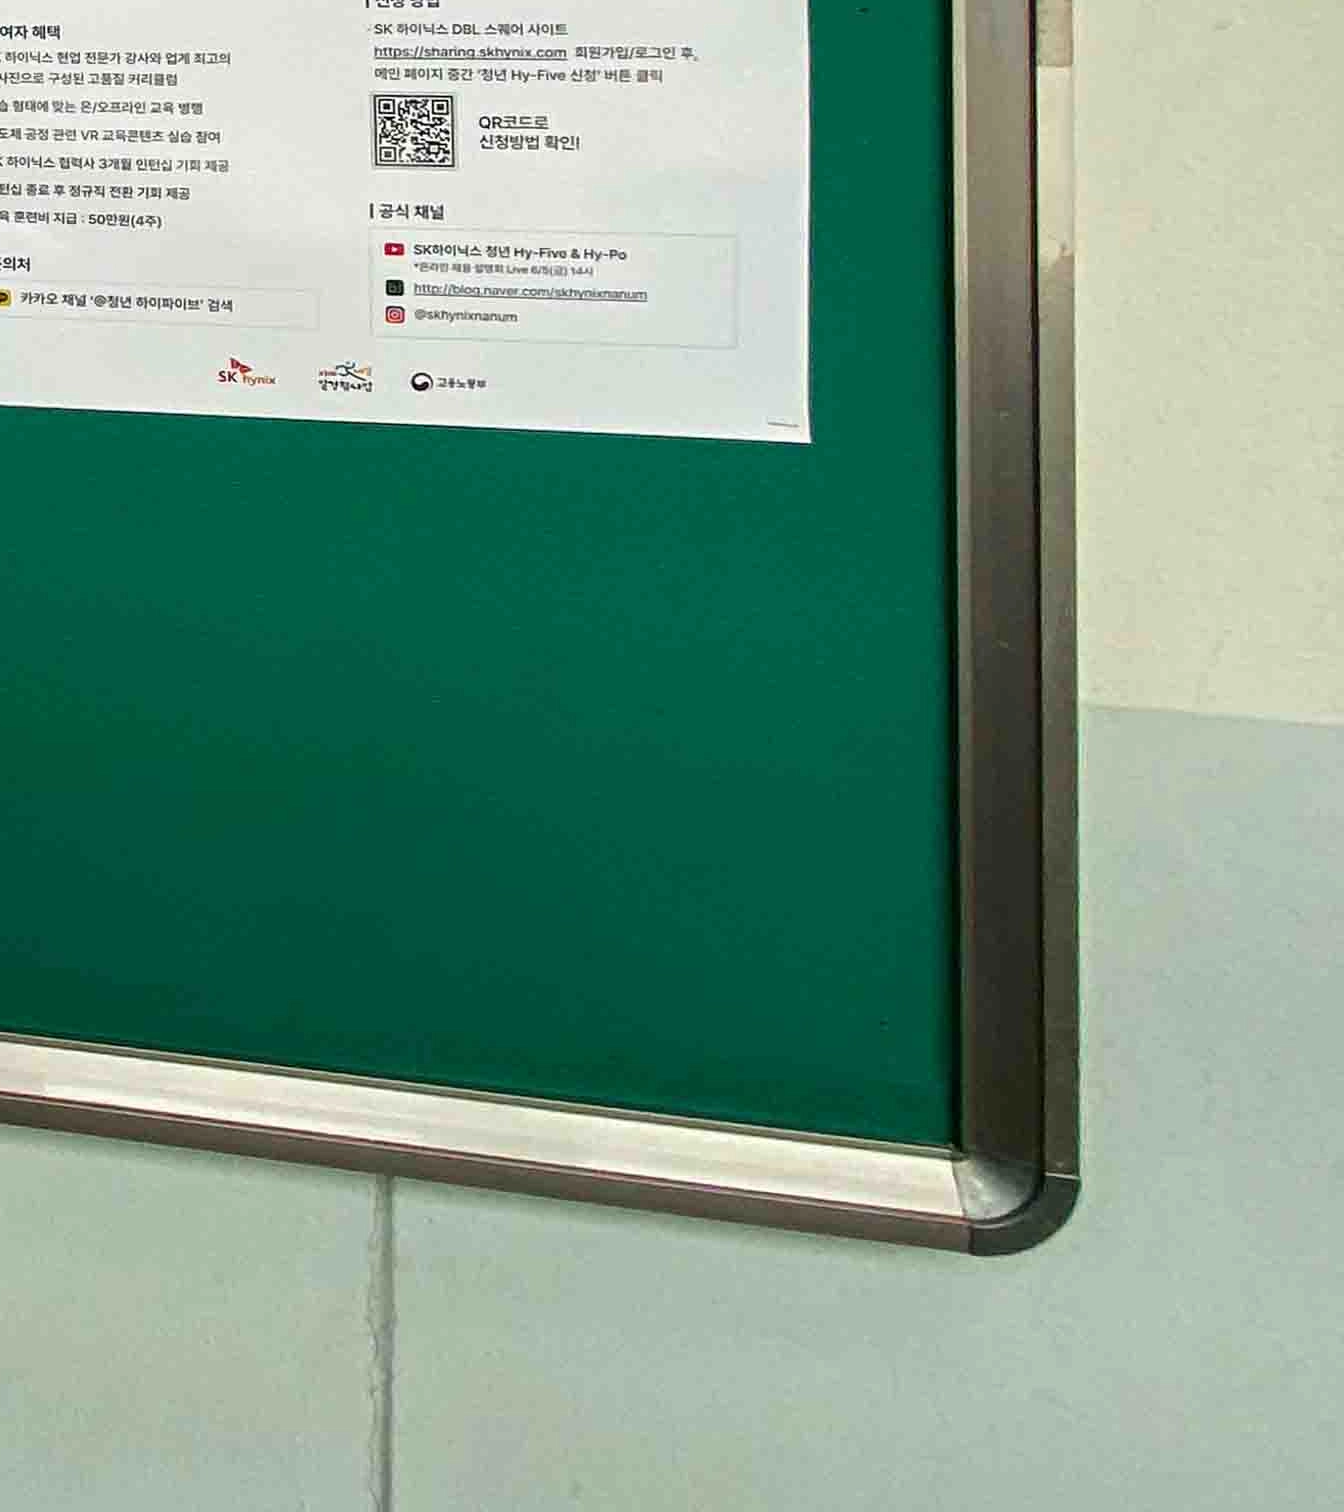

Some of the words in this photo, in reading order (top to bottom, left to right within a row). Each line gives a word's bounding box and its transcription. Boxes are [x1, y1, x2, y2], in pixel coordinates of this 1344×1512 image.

[32, 25, 60, 40] 혜택
[479, 116, 549, 129] QR코드로
[480, 134, 539, 150] 신청방법
[544, 136, 579, 150] 확인!
[379, 204, 409, 219] 공식
[414, 205, 444, 220] 채널
[414, 244, 481, 256] SK하이닉스
[486, 246, 510, 258] 청년
[514, 248, 567, 260] Hy-Five
[571, 249, 580, 259] &
[584, 249, 627, 261] Hy-Po
